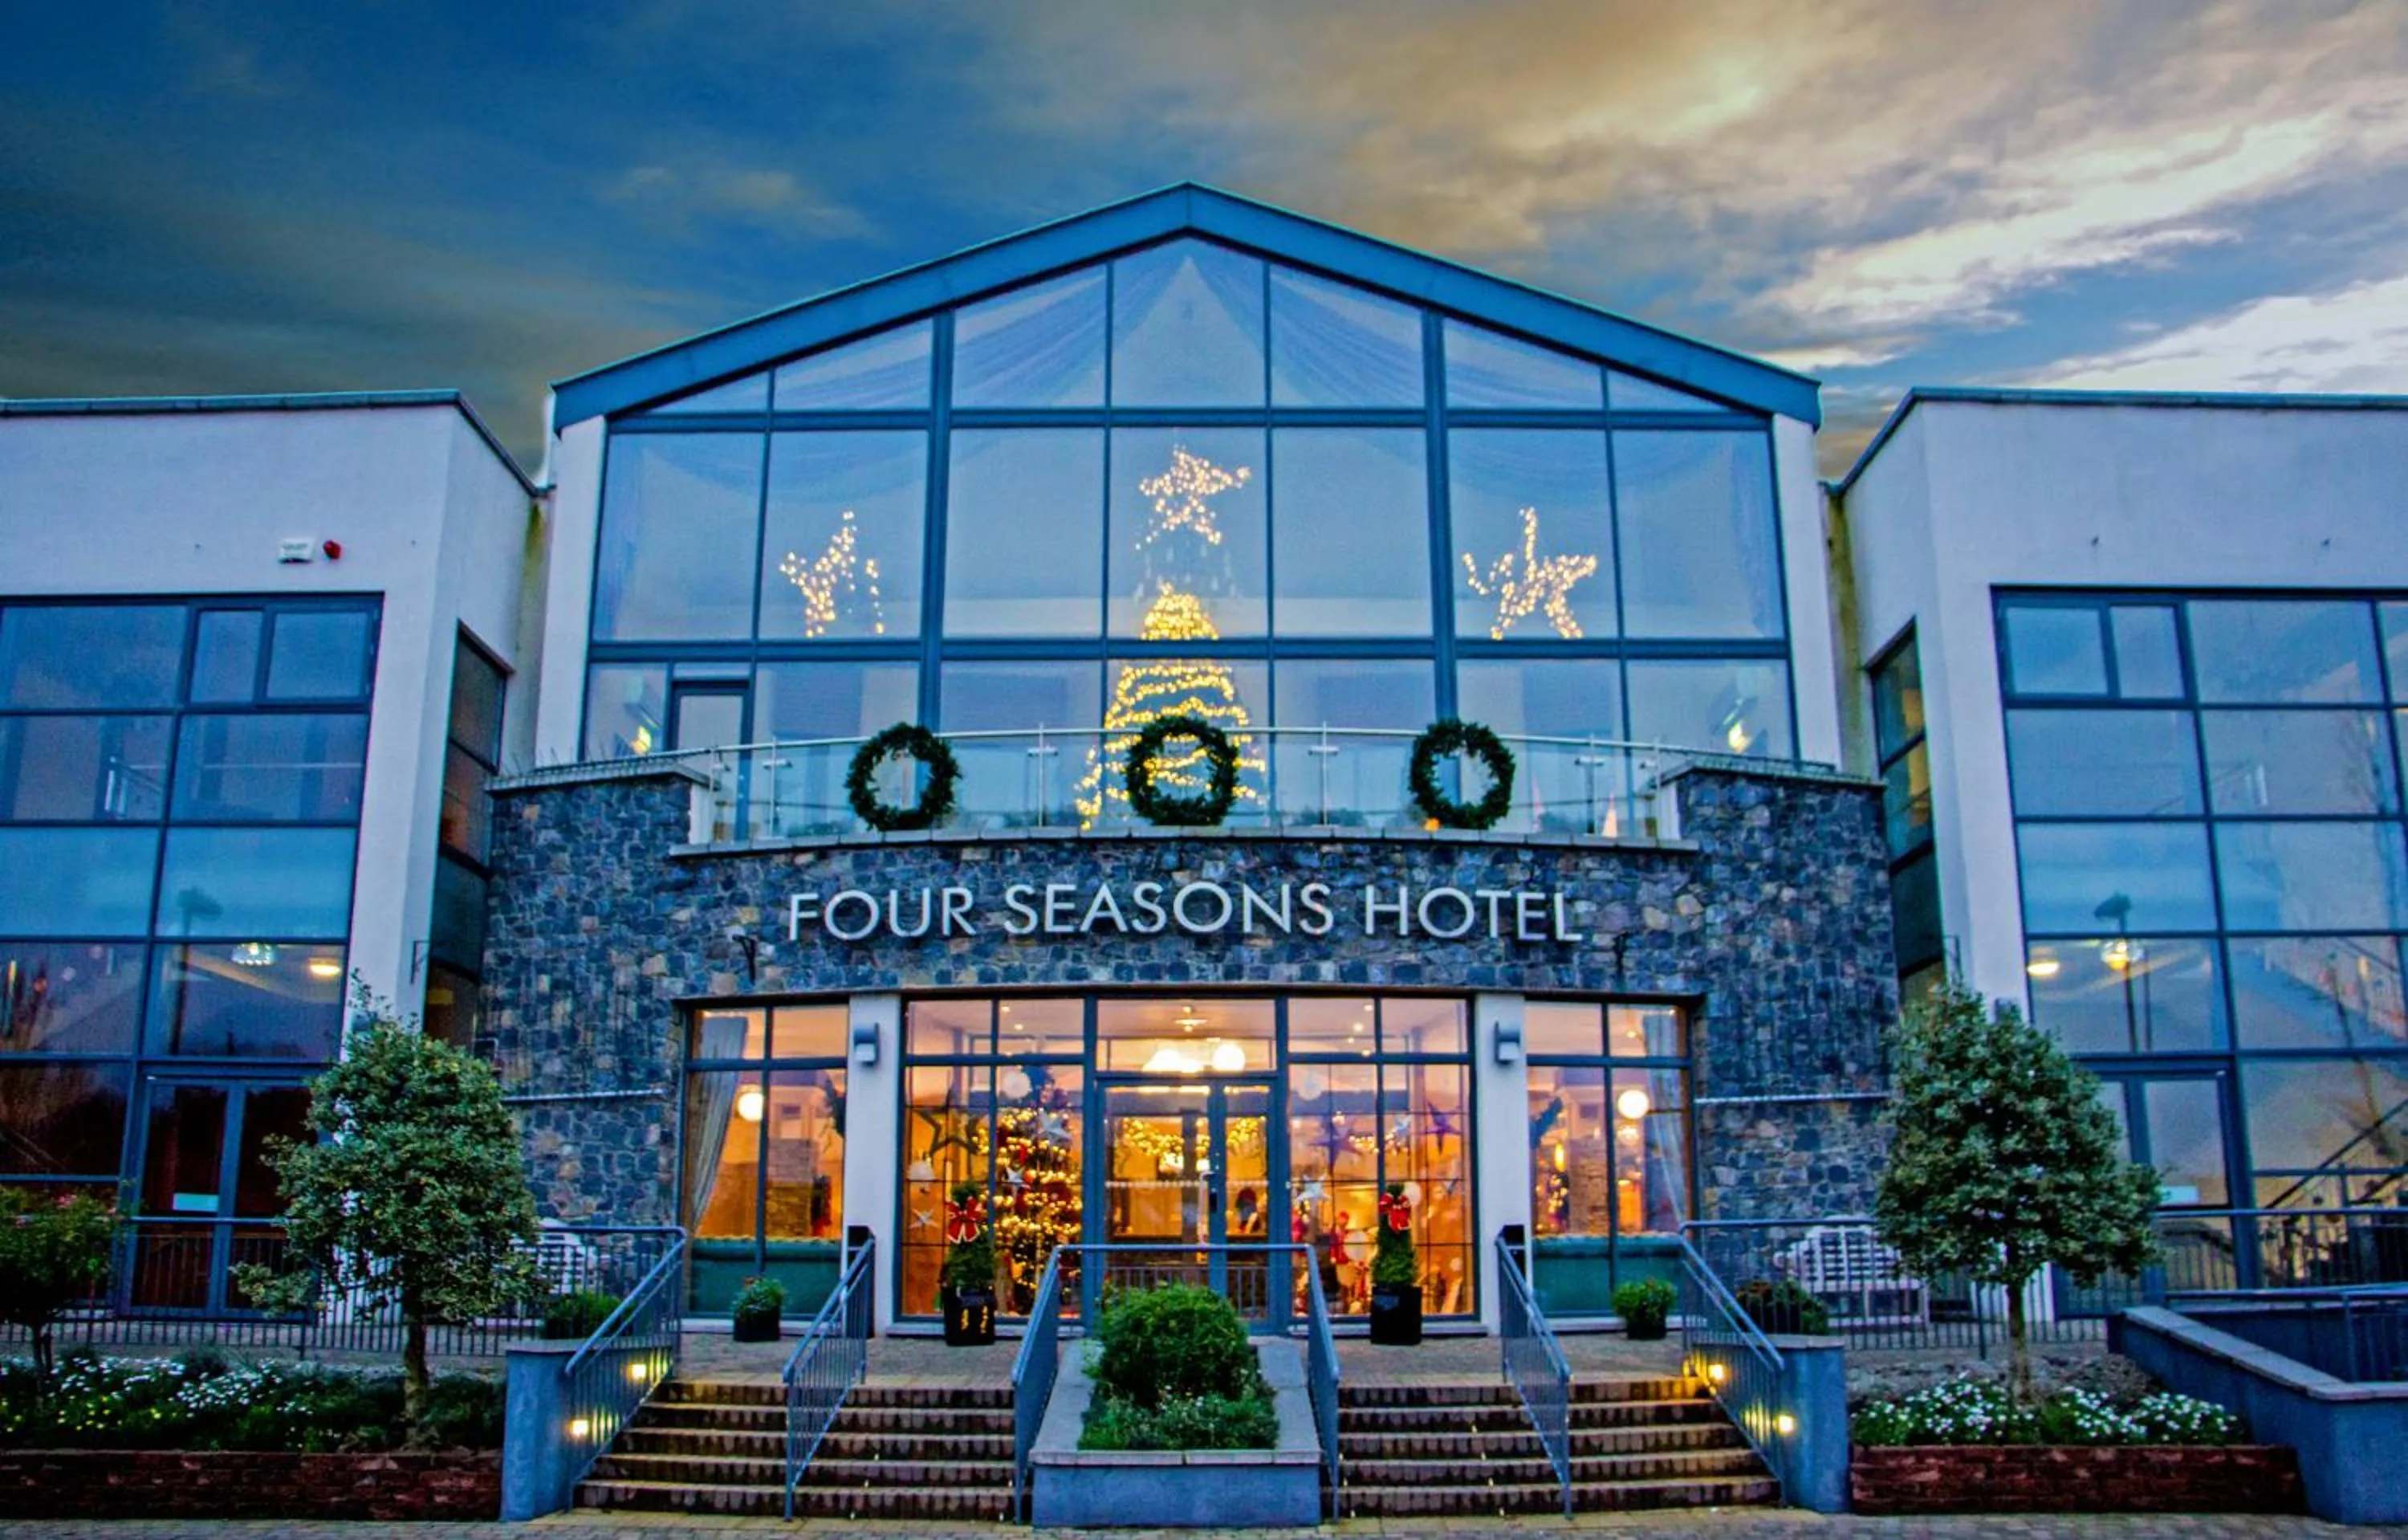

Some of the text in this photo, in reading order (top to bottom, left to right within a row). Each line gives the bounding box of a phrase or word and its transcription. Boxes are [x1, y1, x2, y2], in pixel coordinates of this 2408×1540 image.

[788, 882, 1583, 942] FOUR SEASONS HOTEL
